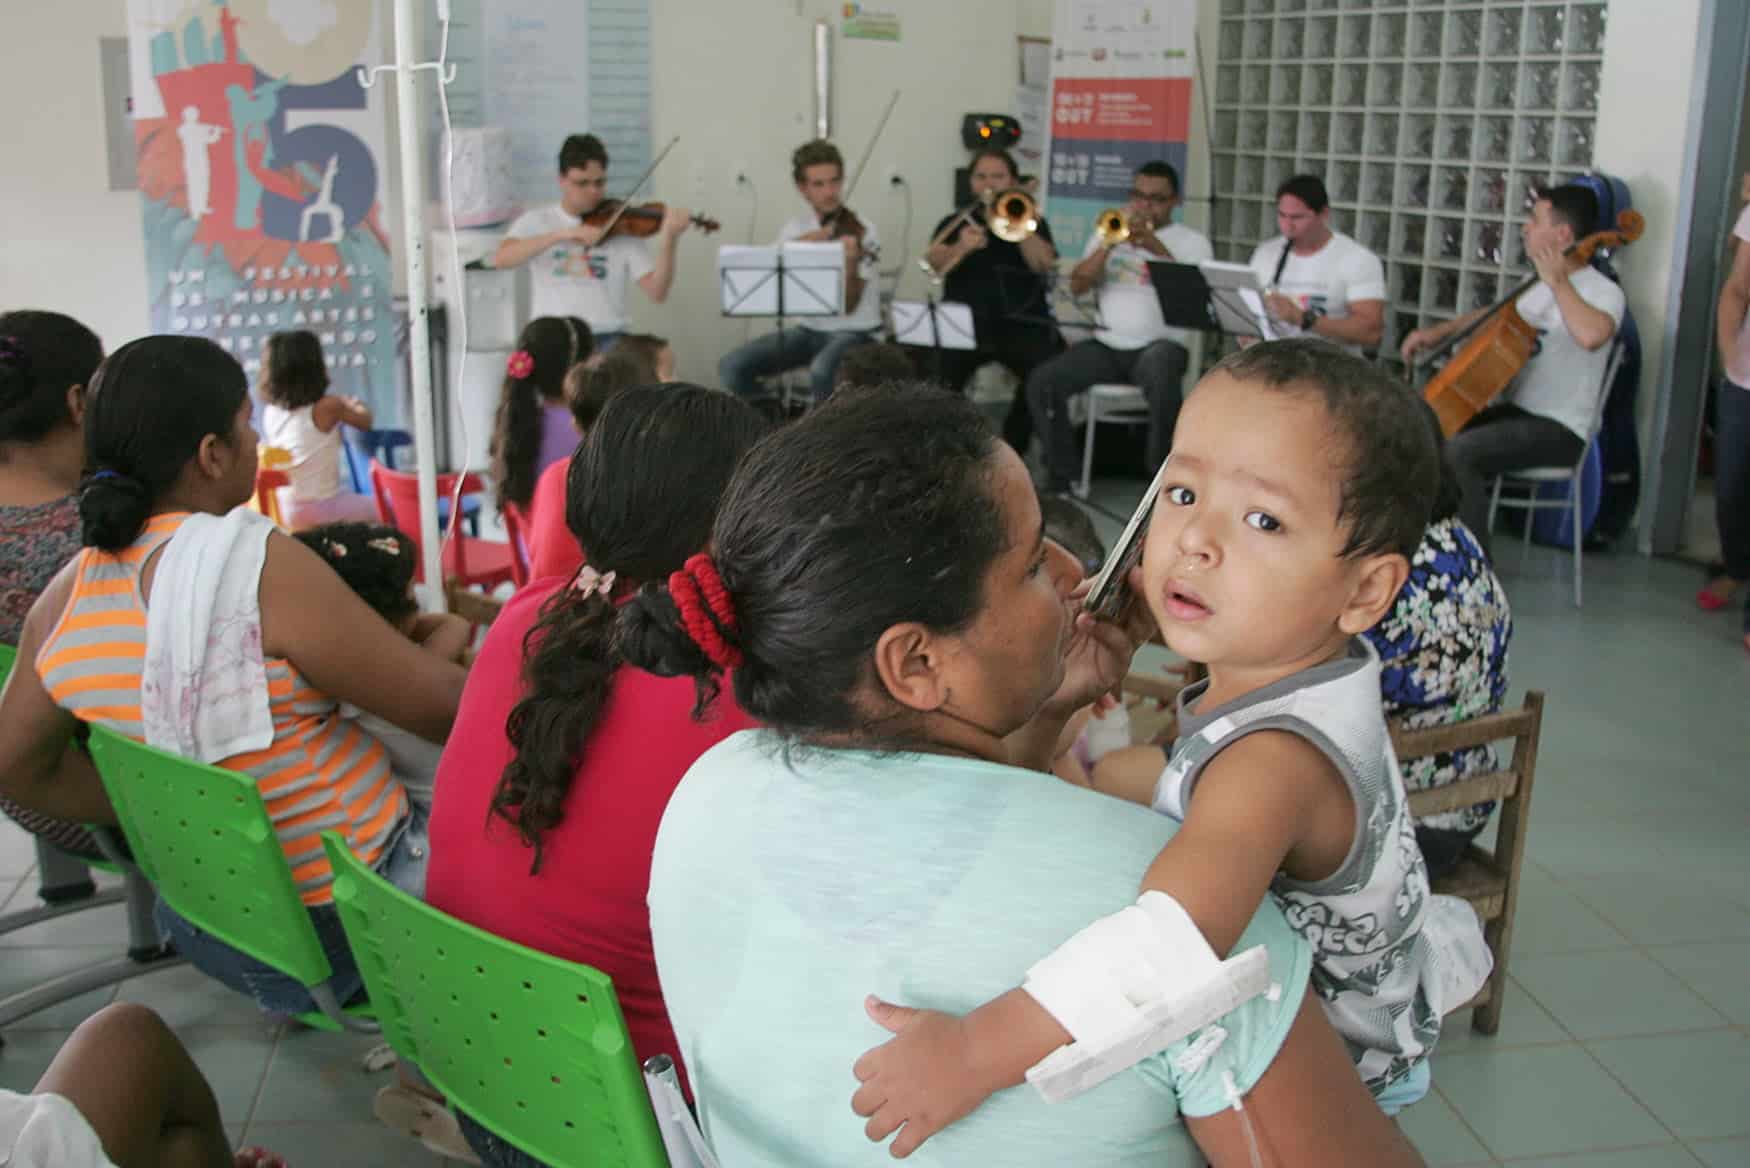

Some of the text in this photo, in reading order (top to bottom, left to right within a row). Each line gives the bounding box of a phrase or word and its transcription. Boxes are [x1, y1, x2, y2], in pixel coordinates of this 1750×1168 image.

[168, 264, 372, 284] UM FESTIVAL
[172, 306, 375, 330] OUTRAS ARTES
